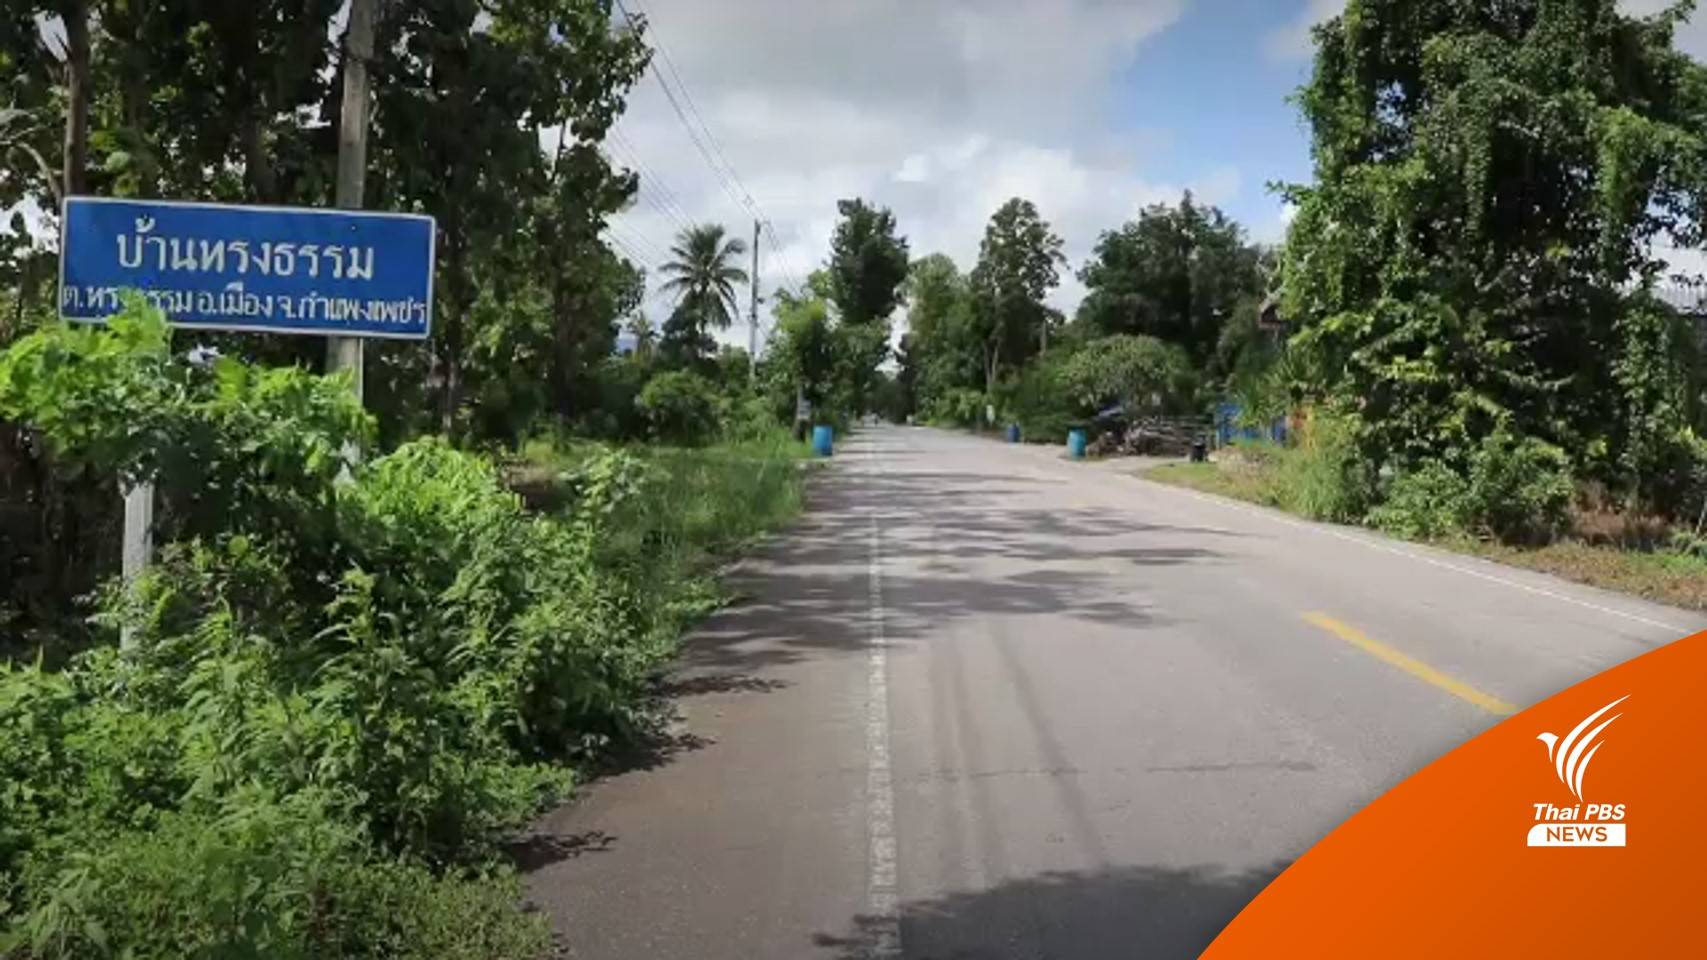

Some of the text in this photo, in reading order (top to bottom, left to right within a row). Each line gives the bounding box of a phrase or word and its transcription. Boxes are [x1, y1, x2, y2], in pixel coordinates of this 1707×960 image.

[116, 216, 374, 280] บ้านทรงธรรม
[63, 281, 426, 325] ต.ทรรรม อ.เมือง จ.กำแพงเพชร
